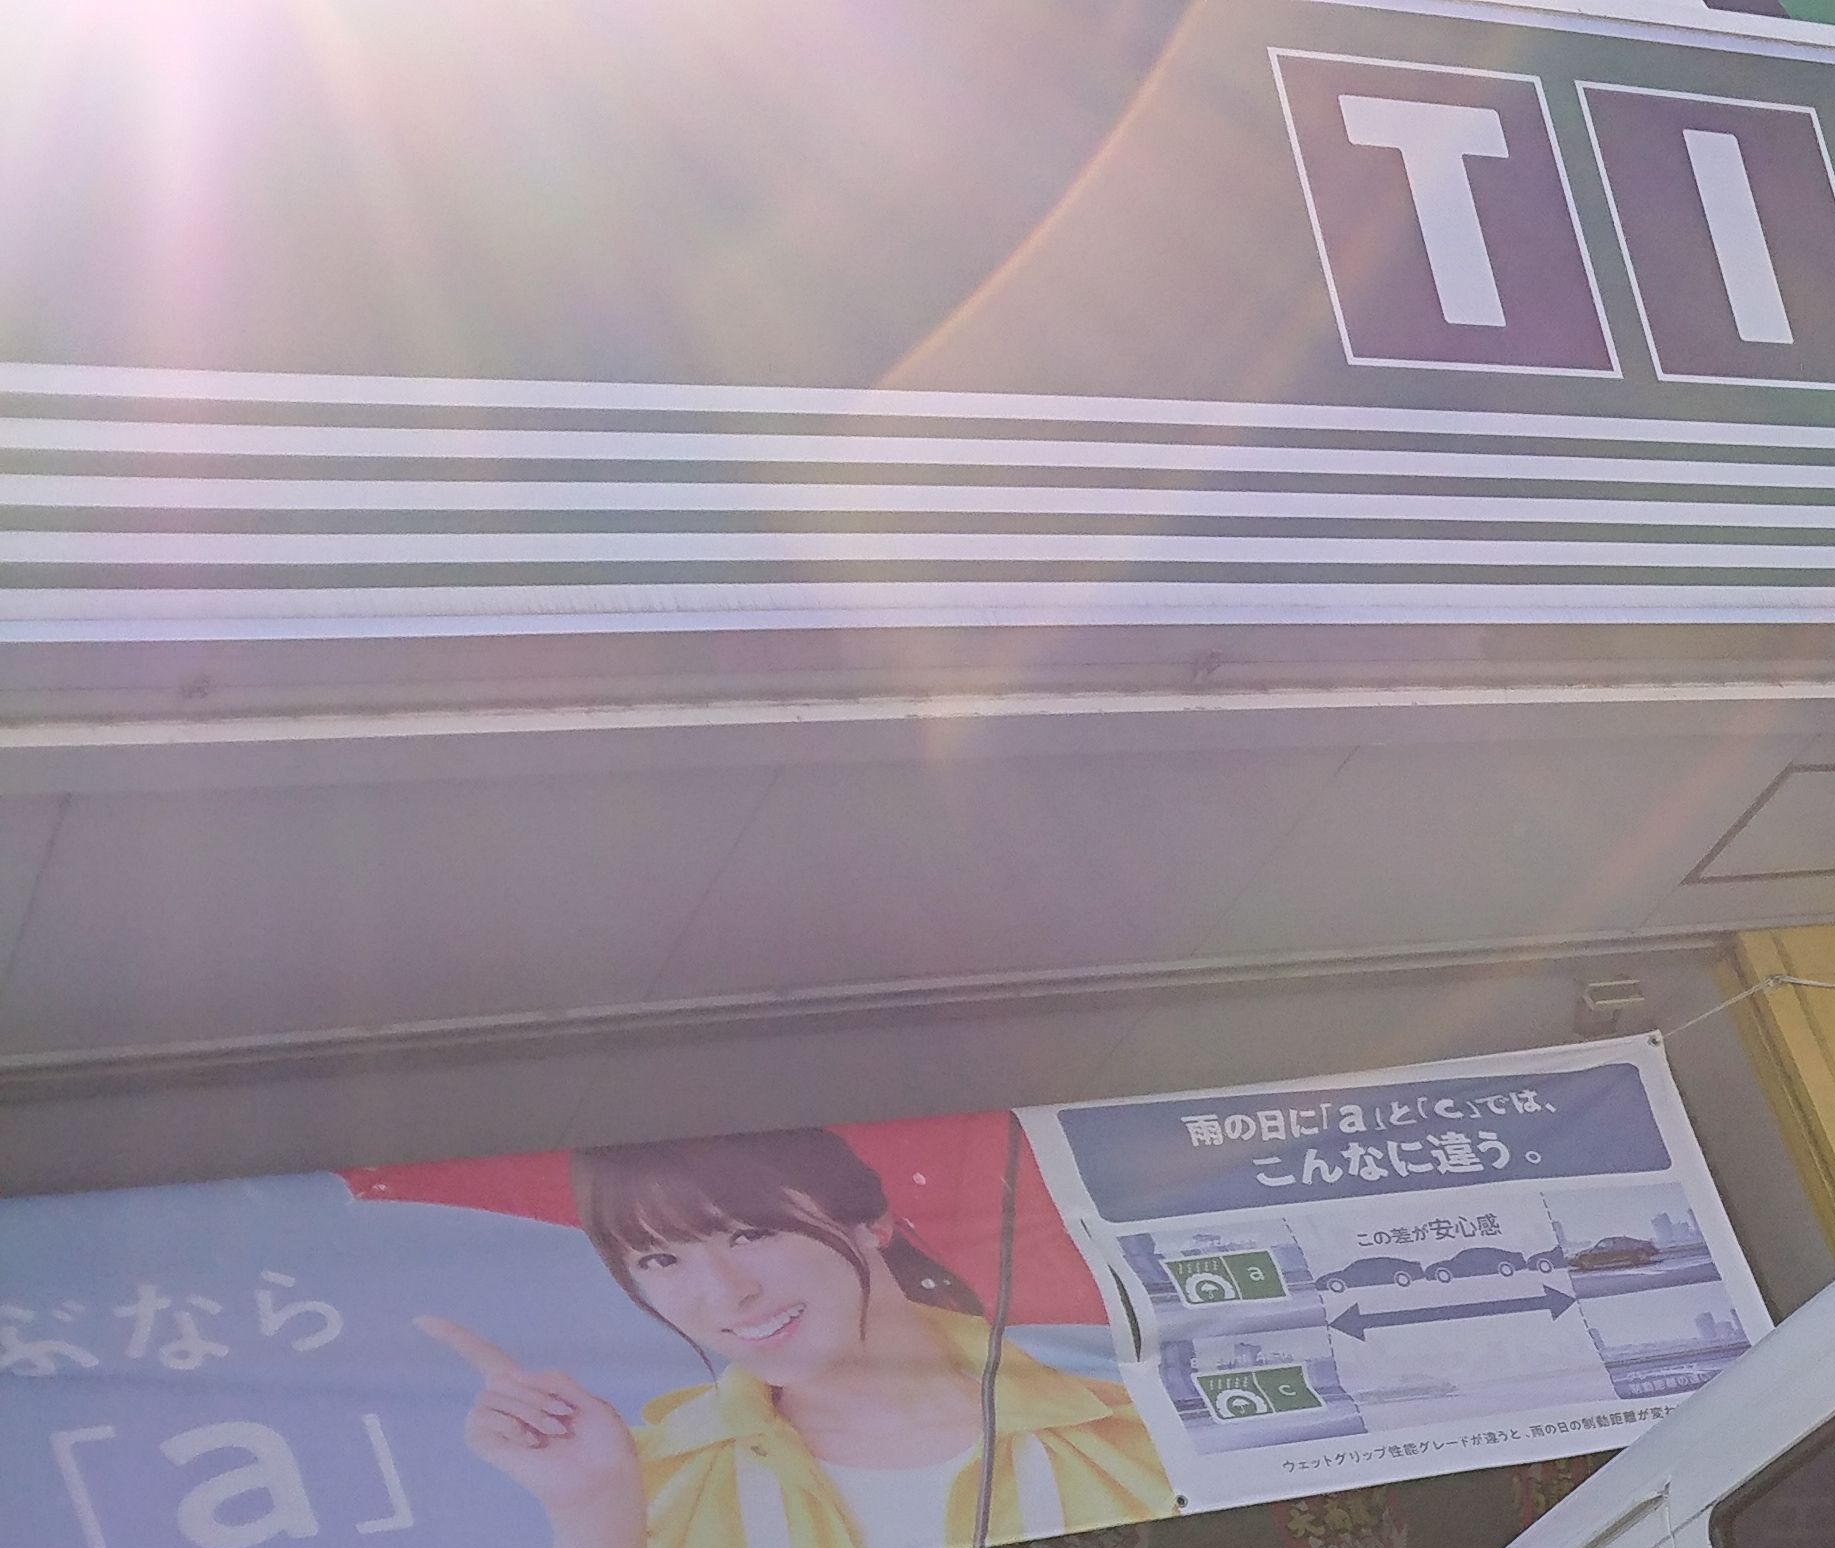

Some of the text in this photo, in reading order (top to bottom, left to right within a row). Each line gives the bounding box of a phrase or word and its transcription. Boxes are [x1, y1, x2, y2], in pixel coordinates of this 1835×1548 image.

[1253, 1131, 1545, 1188] こんなに違う。
[1356, 1213, 1503, 1247] この差が安心感
[1246, 1263, 1266, 1284] a
[1277, 1382, 1299, 1398] c
